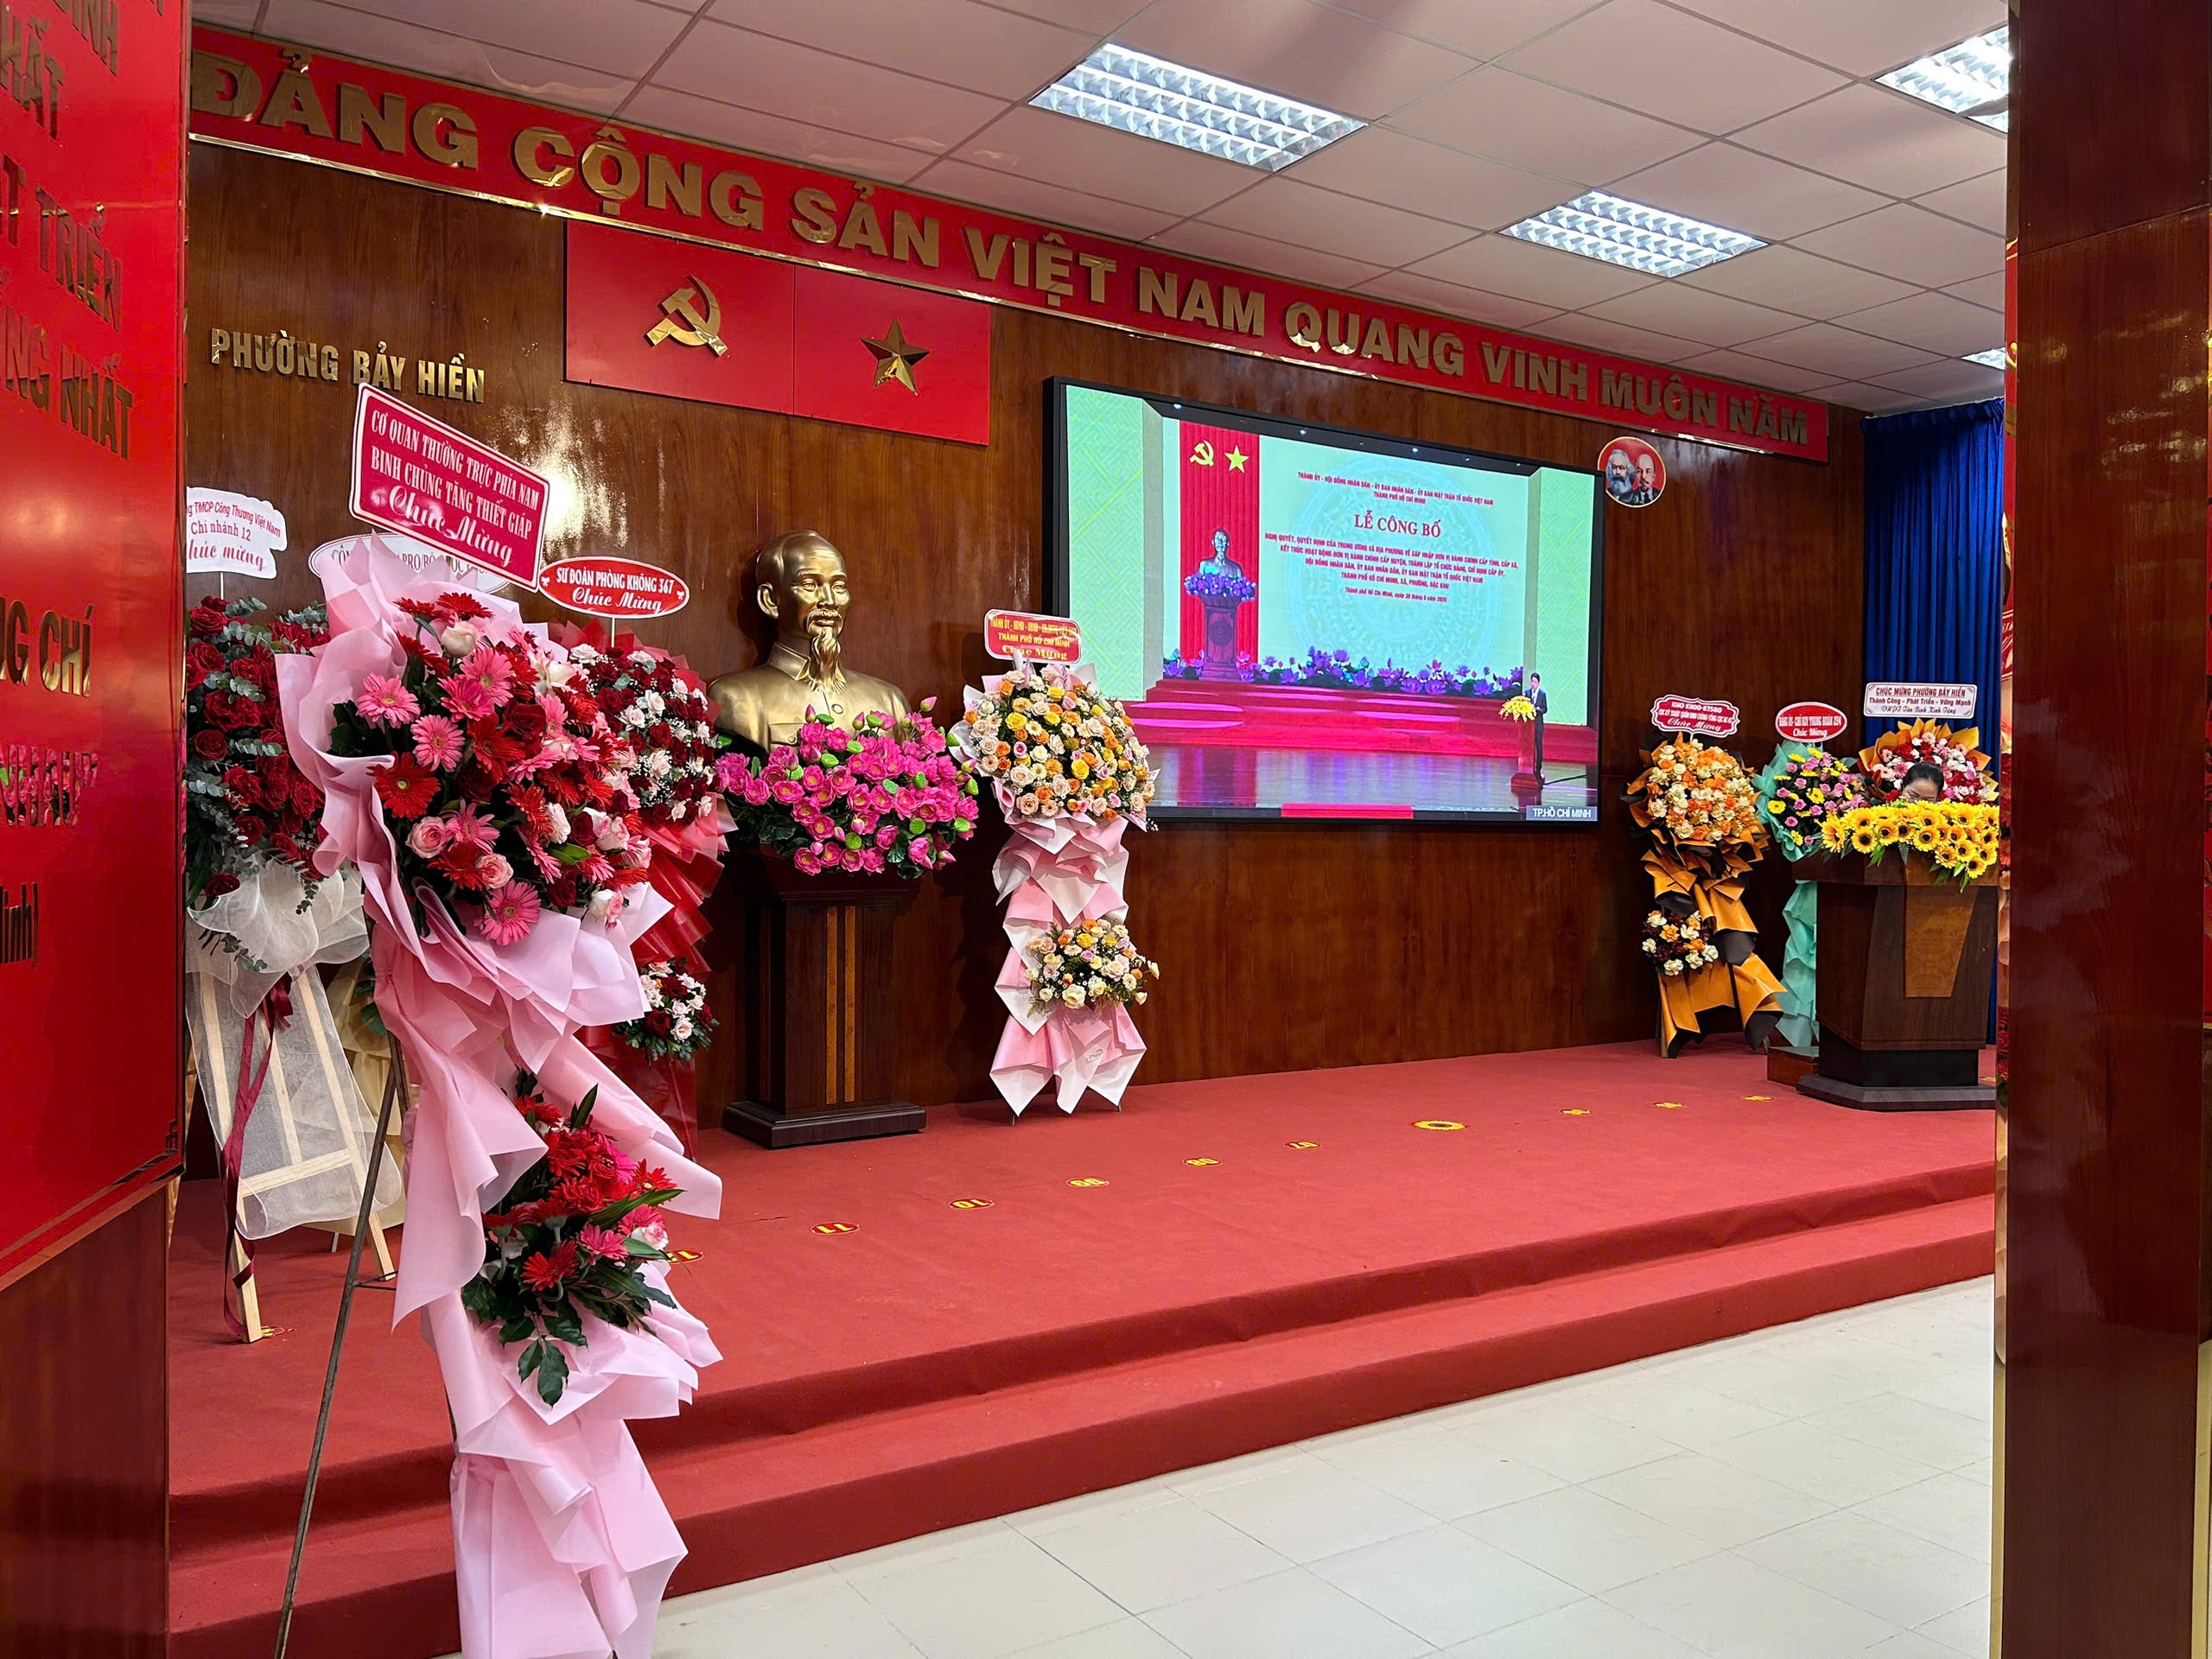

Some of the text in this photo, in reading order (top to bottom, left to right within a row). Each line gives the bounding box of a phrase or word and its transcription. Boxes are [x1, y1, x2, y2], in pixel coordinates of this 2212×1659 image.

[192, 47, 1808, 445] ĐẢNG CỘNG SẢN VIỆT NAM QUANG VINH MUÔN NĂM
[211, 328, 486, 404] PHƯỜNG BẢY HIỀN
[371, 410, 540, 512] CƠ QUAN THƯỜNG TRỰC PHÍA NAM
[371, 446, 533, 540] BINH CHỦNG TĂNG THIẾT GIÁP
[190, 520, 251, 542] Chi nhánh 12
[194, 501, 213, 514] TMCP
[215, 502, 231, 518] Công
[254, 512, 266, 530] Việt
[266, 521, 281, 538] Nam
[1354, 510, 1441, 538] LỄ CÔNG BỐ
[187, 539, 265, 572] húc mừng
[442, 515, 513, 568] Mừng
[556, 567, 675, 594] SƯ ĐOÀN PHÒNG KHÔNG 367
[572, 587, 663, 614] Chúc Mừng
[40, 604, 94, 698] CHÍ
[1556, 806, 1571, 818] CHÍ
[1571, 809, 1592, 818] MINH
